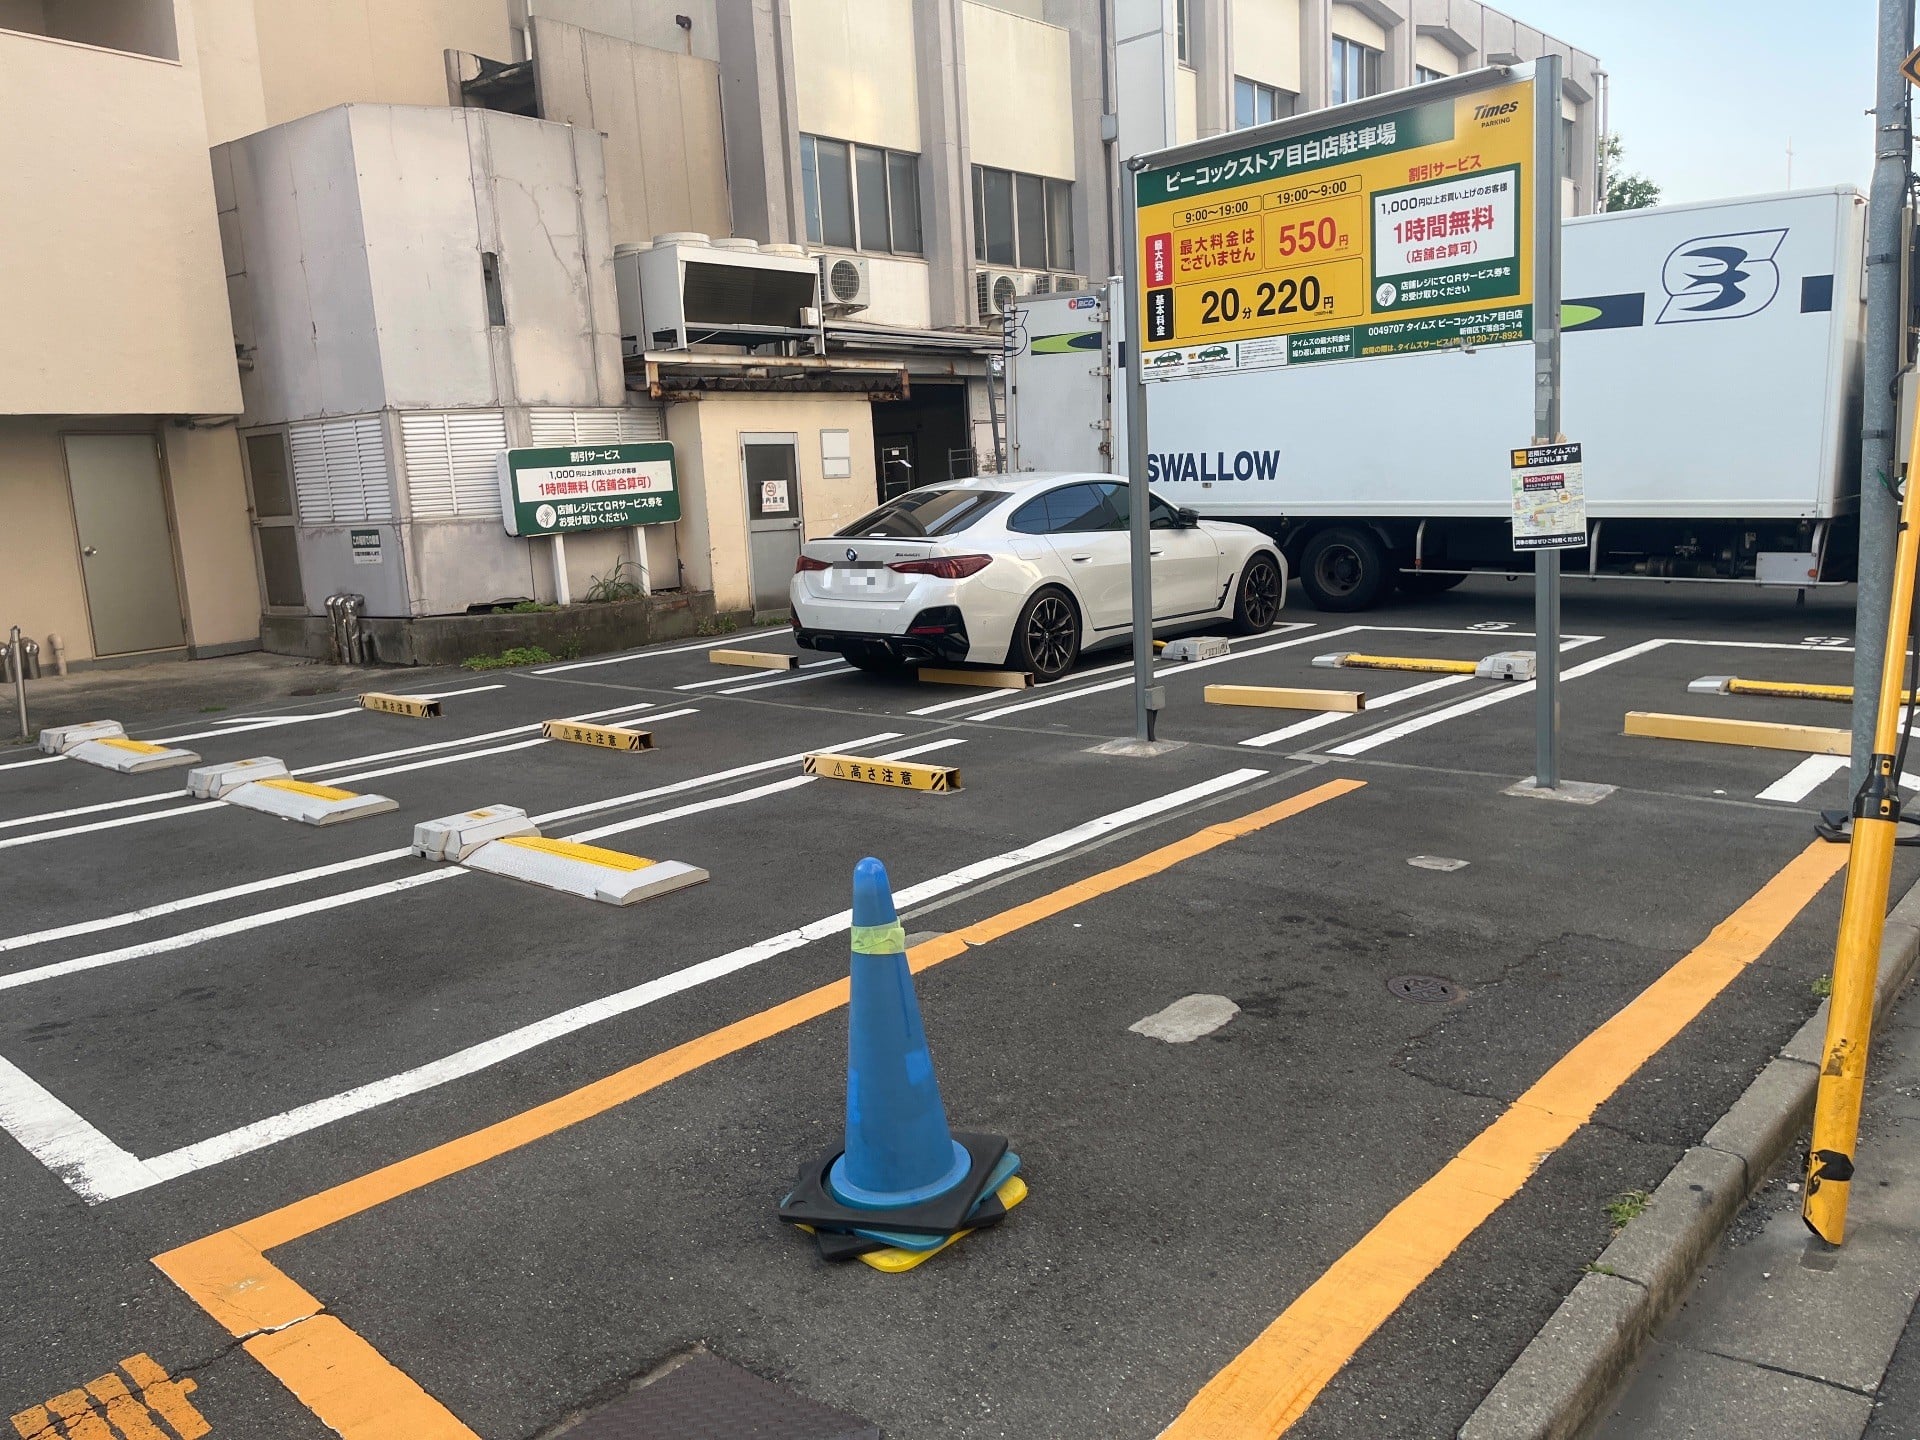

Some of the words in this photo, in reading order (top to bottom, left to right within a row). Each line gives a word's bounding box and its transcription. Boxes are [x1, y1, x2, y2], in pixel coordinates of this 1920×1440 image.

[1473, 100, 1519, 121] Times
[1481, 116, 1511, 128] PARKING
[1166, 121, 1397, 192] ピーコックストア目白店駐車場
[1408, 154, 1482, 183] 割引サービス
[1381, 182, 1508, 215] 1,000円以上お買い上げのお客様
[1393, 204, 1495, 244] 1時間無料
[1180, 228, 1255, 256] 最大料金は
[1406, 240, 1478, 264] （店舗合算可）
[1153, 239, 1165, 282] 最大料金
[1180, 247, 1256, 272] ございません
[1401, 266, 1511, 291] 店舗レジにてQRサービス券を
[1401, 285, 1471, 302] お受け取りください
[1155, 294, 1167, 337] 基本料金
[1201, 287, 1252, 325] 20分
[1368, 323, 1405, 337] 0049707
[1406, 319, 1437, 332] タイムズ
[1438, 310, 1523, 328] ピーコックストア目白店
[1292, 334, 1351, 348] タイムズの最大料金は
[1466, 331, 1523, 344] 0120-77-8924
[570, 450, 620, 463] 割引サービス
[1147, 450, 1281, 483] SWALLOW
[1528, 454, 1569, 465] OPENします
[557, 496, 663, 516] 店舗レジにてQRサービス券を
[558, 512, 629, 527] お受け取りください
[574, 729, 617, 747] 高さ注意
[850, 764, 913, 786] 高さ注意
